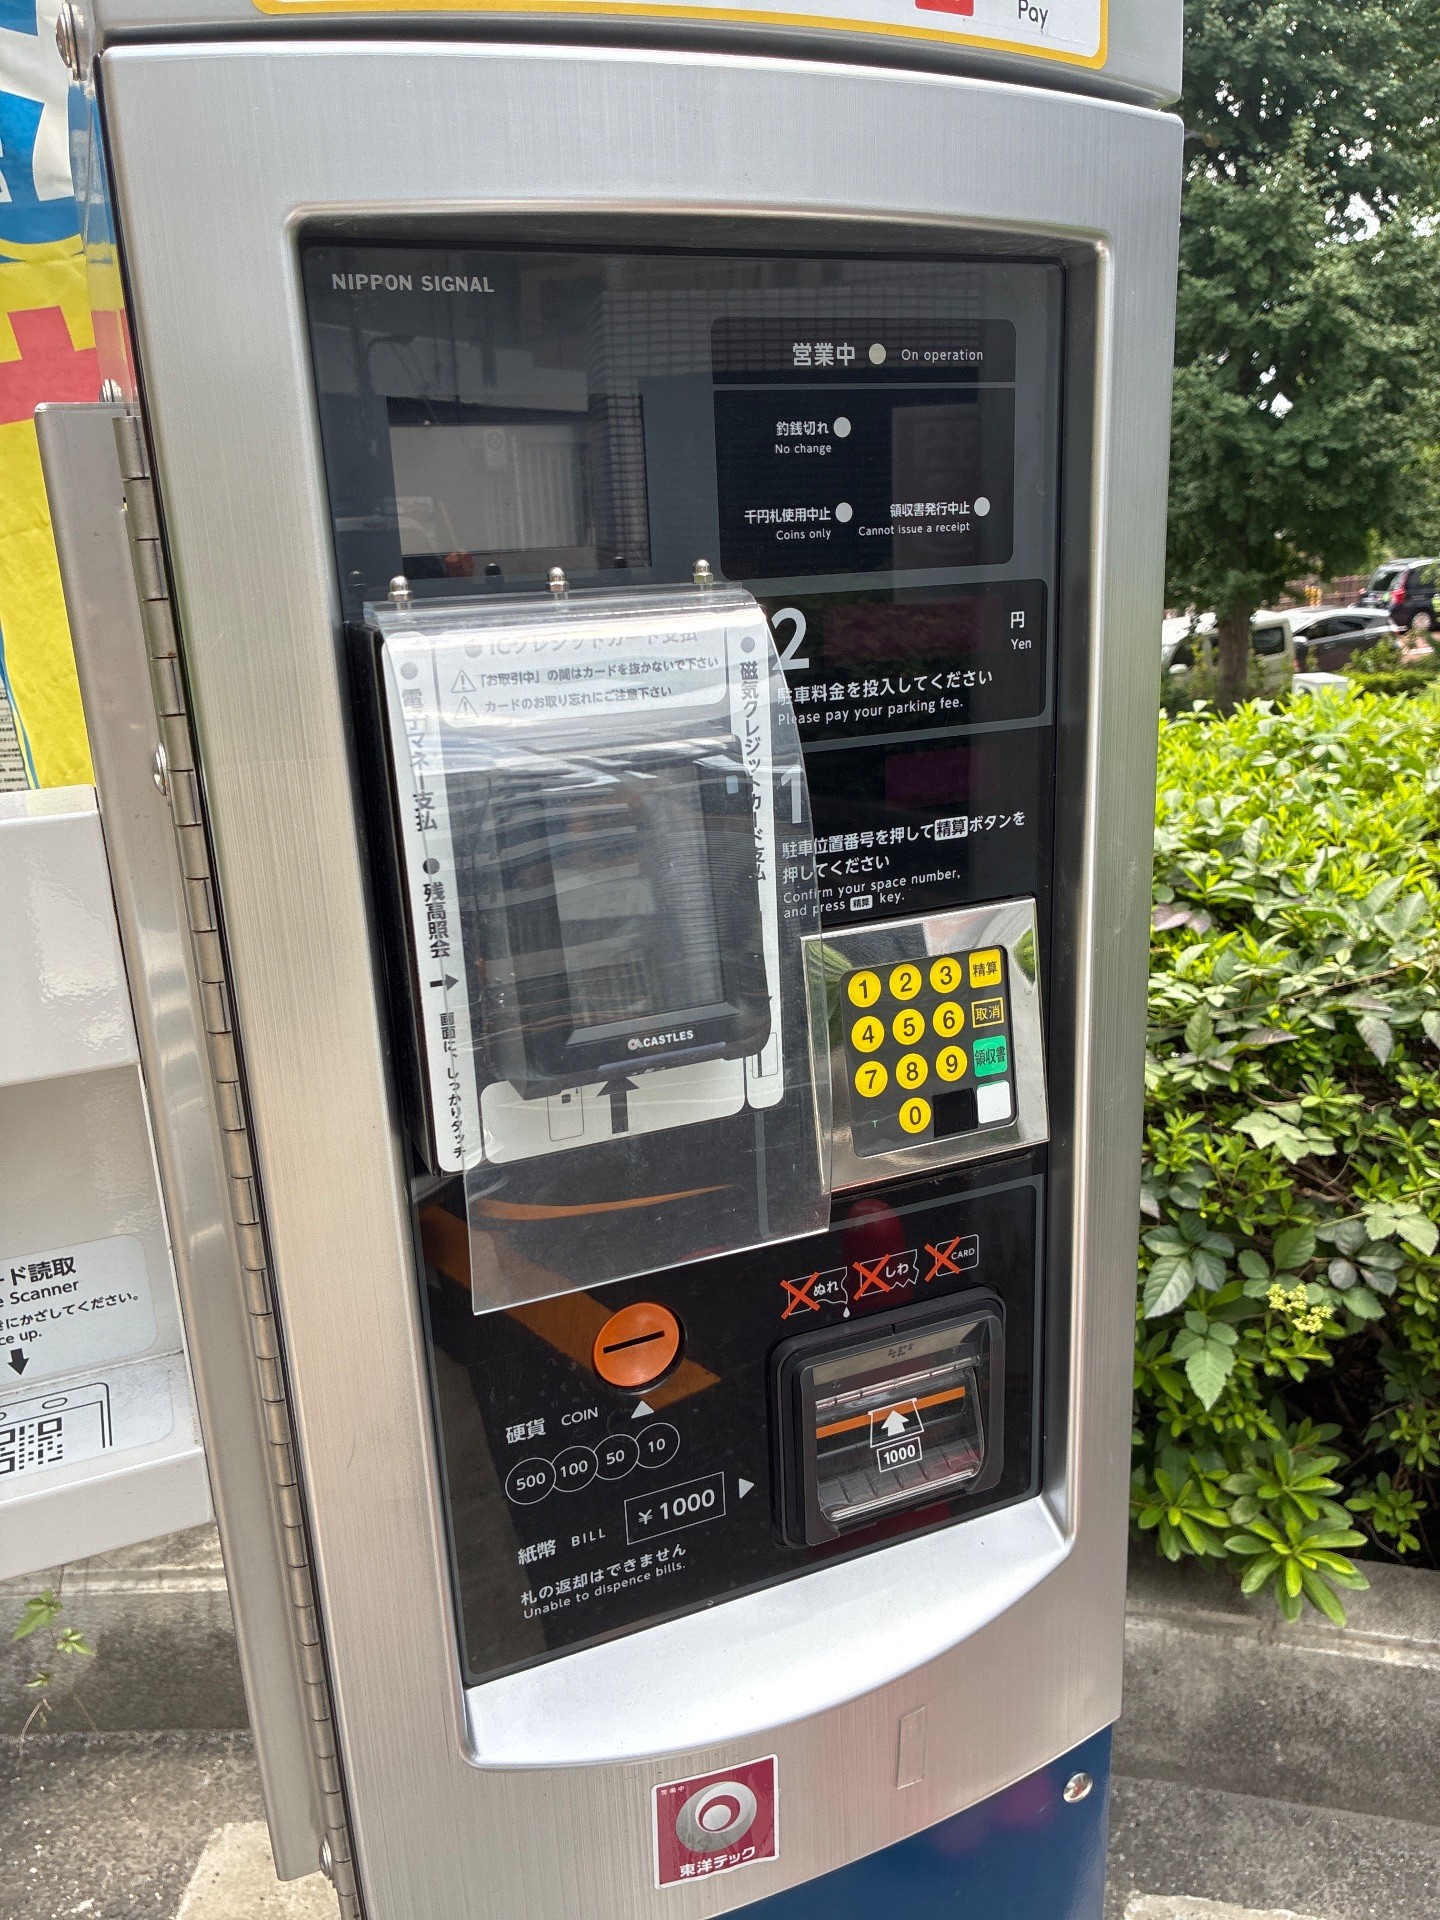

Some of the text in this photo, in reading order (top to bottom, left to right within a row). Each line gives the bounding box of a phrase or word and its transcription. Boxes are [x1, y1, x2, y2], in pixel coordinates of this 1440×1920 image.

[1018, 0, 1048, 30] Pay
[332, 273, 495, 293] NIPPON SIGNAL
[792, 342, 856, 367] 営業中
[901, 348, 983, 362] On operation
[776, 420, 829, 436] 釣銭切れ
[775, 442, 832, 456] No change
[744, 507, 832, 524] 千円札使用中止
[889, 501, 970, 518] 領収書発行中止
[776, 528, 832, 541] Coins only
[858, 521, 970, 536] Cannot issue a receipt
[1010, 611, 1025, 629] 円
[771, 607, 810, 670] 2
[1011, 638, 1032, 650] Yen
[777, 671, 993, 706] 駐車料金を投入してください
[778, 697, 964, 726] Please pay your parking fee.
[780, 768, 802, 824] 1
[782, 855, 890, 884] 押してください
[783, 870, 961, 904] Confirm your space number,
[783, 893, 905, 918] and press 精算 key.
[423, 882, 451, 959] 残高照会
[940, 965, 953, 985] 3
[972, 961, 998, 977] 精算
[859, 979, 869, 999] 1
[900, 972, 913, 993] 2
[943, 1009, 956, 1030] 6
[975, 1005, 1001, 1021] 取消
[862, 1023, 875, 1045] 4
[903, 1017, 916, 1037] 5
[643, 1030, 694, 1047] CASTLES
[946, 1054, 959, 1074] 9
[974, 1045, 1007, 1067] 領収書
[865, 1069, 878, 1090] 7
[906, 1061, 919, 1082] 8
[909, 1106, 922, 1128] 0
[951, 1247, 976, 1260] CARD
[0, 1256, 77, 1286] ド読取
[885, 1262, 909, 1277] しわ
[9, 1280, 80, 1305] Scanner
[813, 1280, 839, 1297] ぬれ
[19, 1329, 43, 1342] up.
[561, 1407, 598, 1426] COIN
[505, 1418, 546, 1444] 硬貨
[648, 1438, 666, 1453] 10
[883, 1444, 917, 1466] 1000
[606, 1449, 626, 1466] 50
[560, 1459, 589, 1478] 100
[516, 1472, 546, 1491] 500
[571, 1528, 606, 1547] BILL
[517, 1539, 557, 1566] 紙幣
[520, 1544, 686, 1606] 札の返却はできません
[523, 1564, 686, 1619] Unable to dispence bills.
[679, 1845, 756, 1878] 東洋テック
